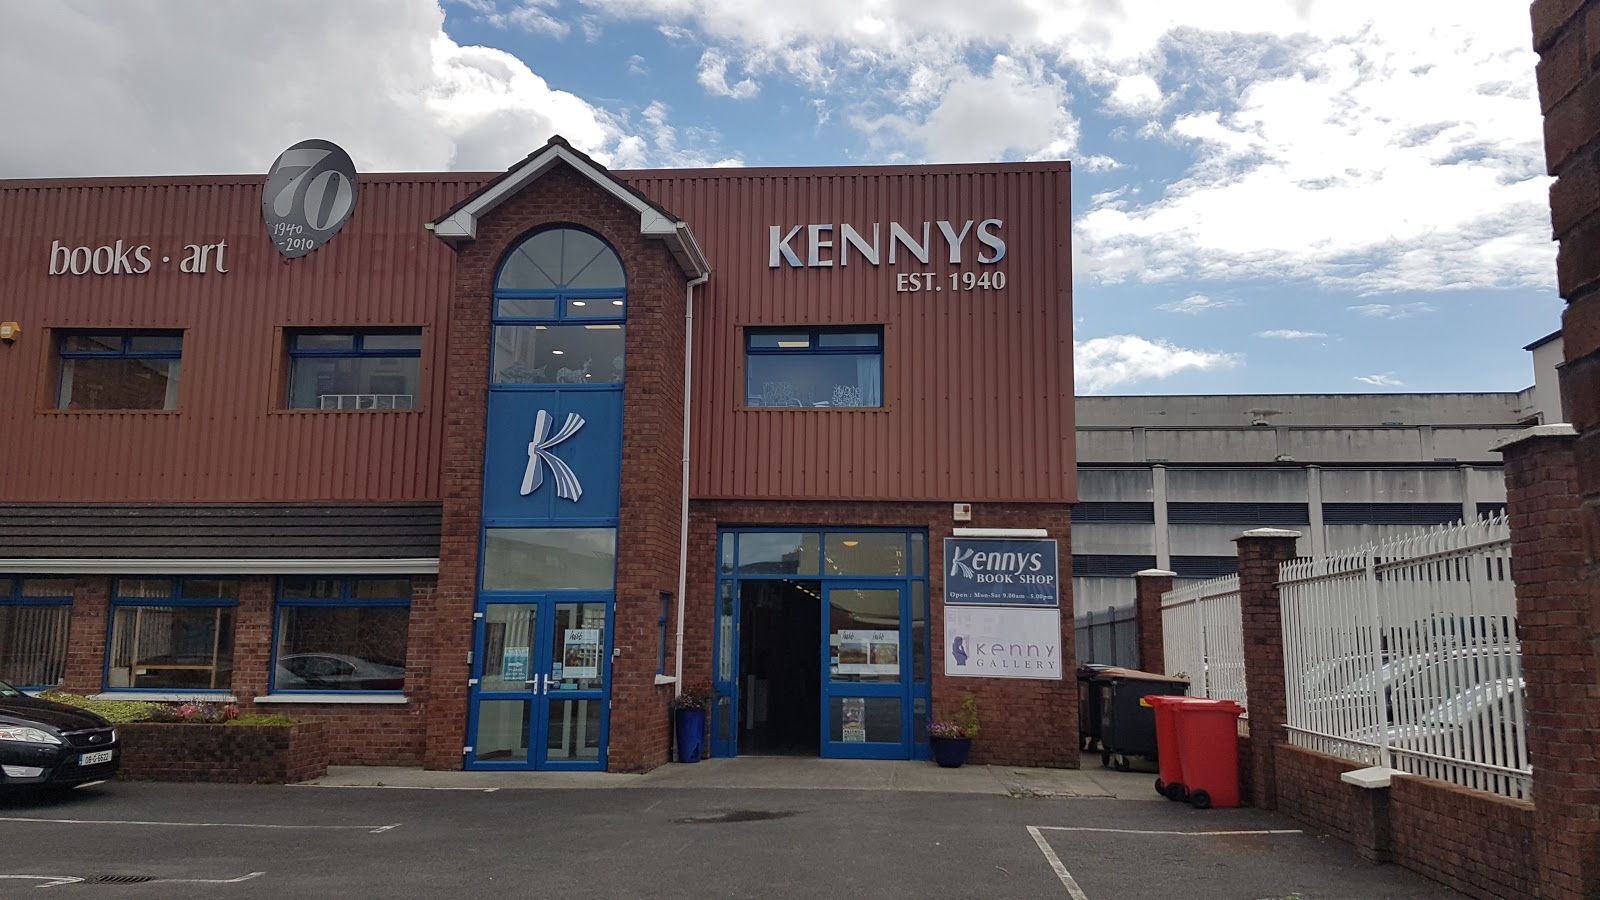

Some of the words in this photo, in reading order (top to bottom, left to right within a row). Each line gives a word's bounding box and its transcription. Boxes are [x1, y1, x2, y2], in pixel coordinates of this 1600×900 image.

[274, 149, 353, 230] 70
[274, 222, 303, 236] 1940
[768, 218, 1006, 268] KENNYS
[49, 239, 151, 275] books
[180, 239, 229, 273] art
[896, 272, 942, 292] EST.
[949, 271, 1006, 291] 1940
[950, 546, 1042, 579] Kennys
[977, 574, 1014, 584] BOOK
[1019, 574, 1054, 585] SHOP
[949, 591, 968, 599] Open
[976, 658, 1055, 669] GALLERY
